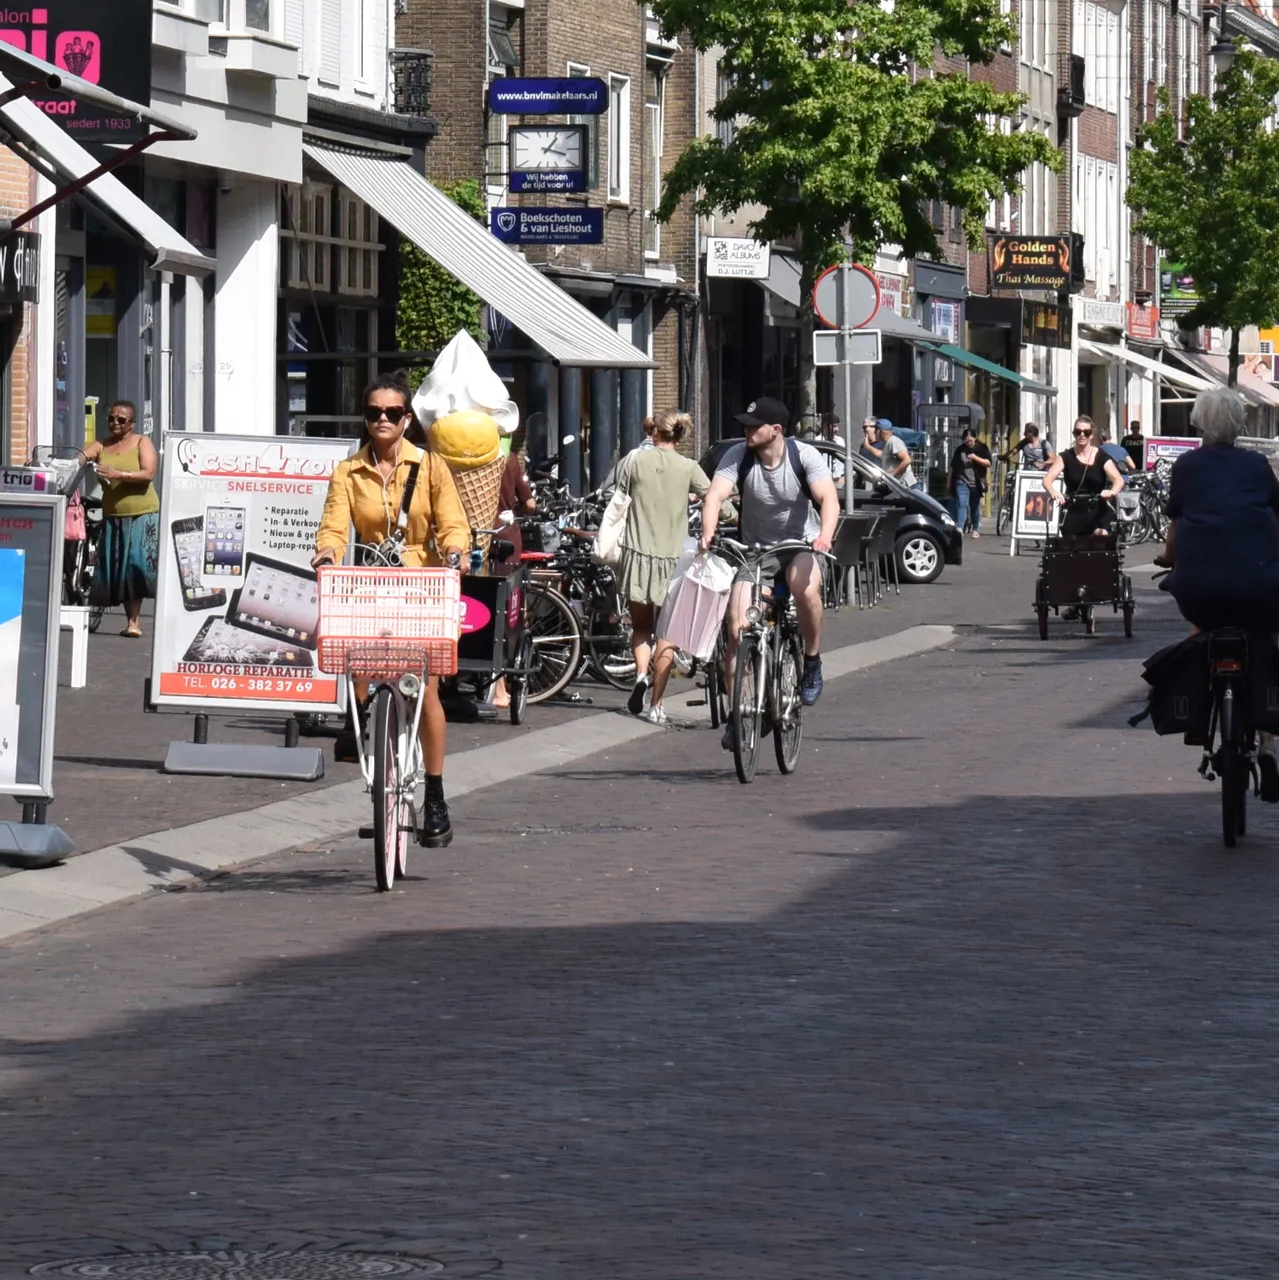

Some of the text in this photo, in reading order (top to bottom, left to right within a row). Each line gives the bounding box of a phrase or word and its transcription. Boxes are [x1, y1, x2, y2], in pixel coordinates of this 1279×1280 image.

[65, 118, 131, 129] sedert 1933
[540, 173, 569, 181] hebben
[533, 181, 546, 190] tijd
[520, 212, 582, 223] Boekschoten
[520, 223, 592, 233] & van Lieshout
[1008, 241, 1056, 252] Golden
[730, 252, 760, 260] ALBUMS
[1012, 254, 1054, 265] Hands
[996, 271, 1065, 289] Thai Massage
[3, 470, 33, 485] trio
[228, 481, 313, 495] SNELSERVICE
[271, 506, 309, 516] Reparatie
[269, 530, 294, 539] Nieuw
[297, 531, 303, 539] &
[269, 541, 315, 551] Laptop-repa
[177, 662, 313, 678] HORLOGE REPARATIE
[184, 677, 207, 688] TEL.
[211, 677, 236, 690] 026
[248, 680, 272, 691] 382
[276, 681, 293, 692] 37
[296, 682, 313, 693] 69
